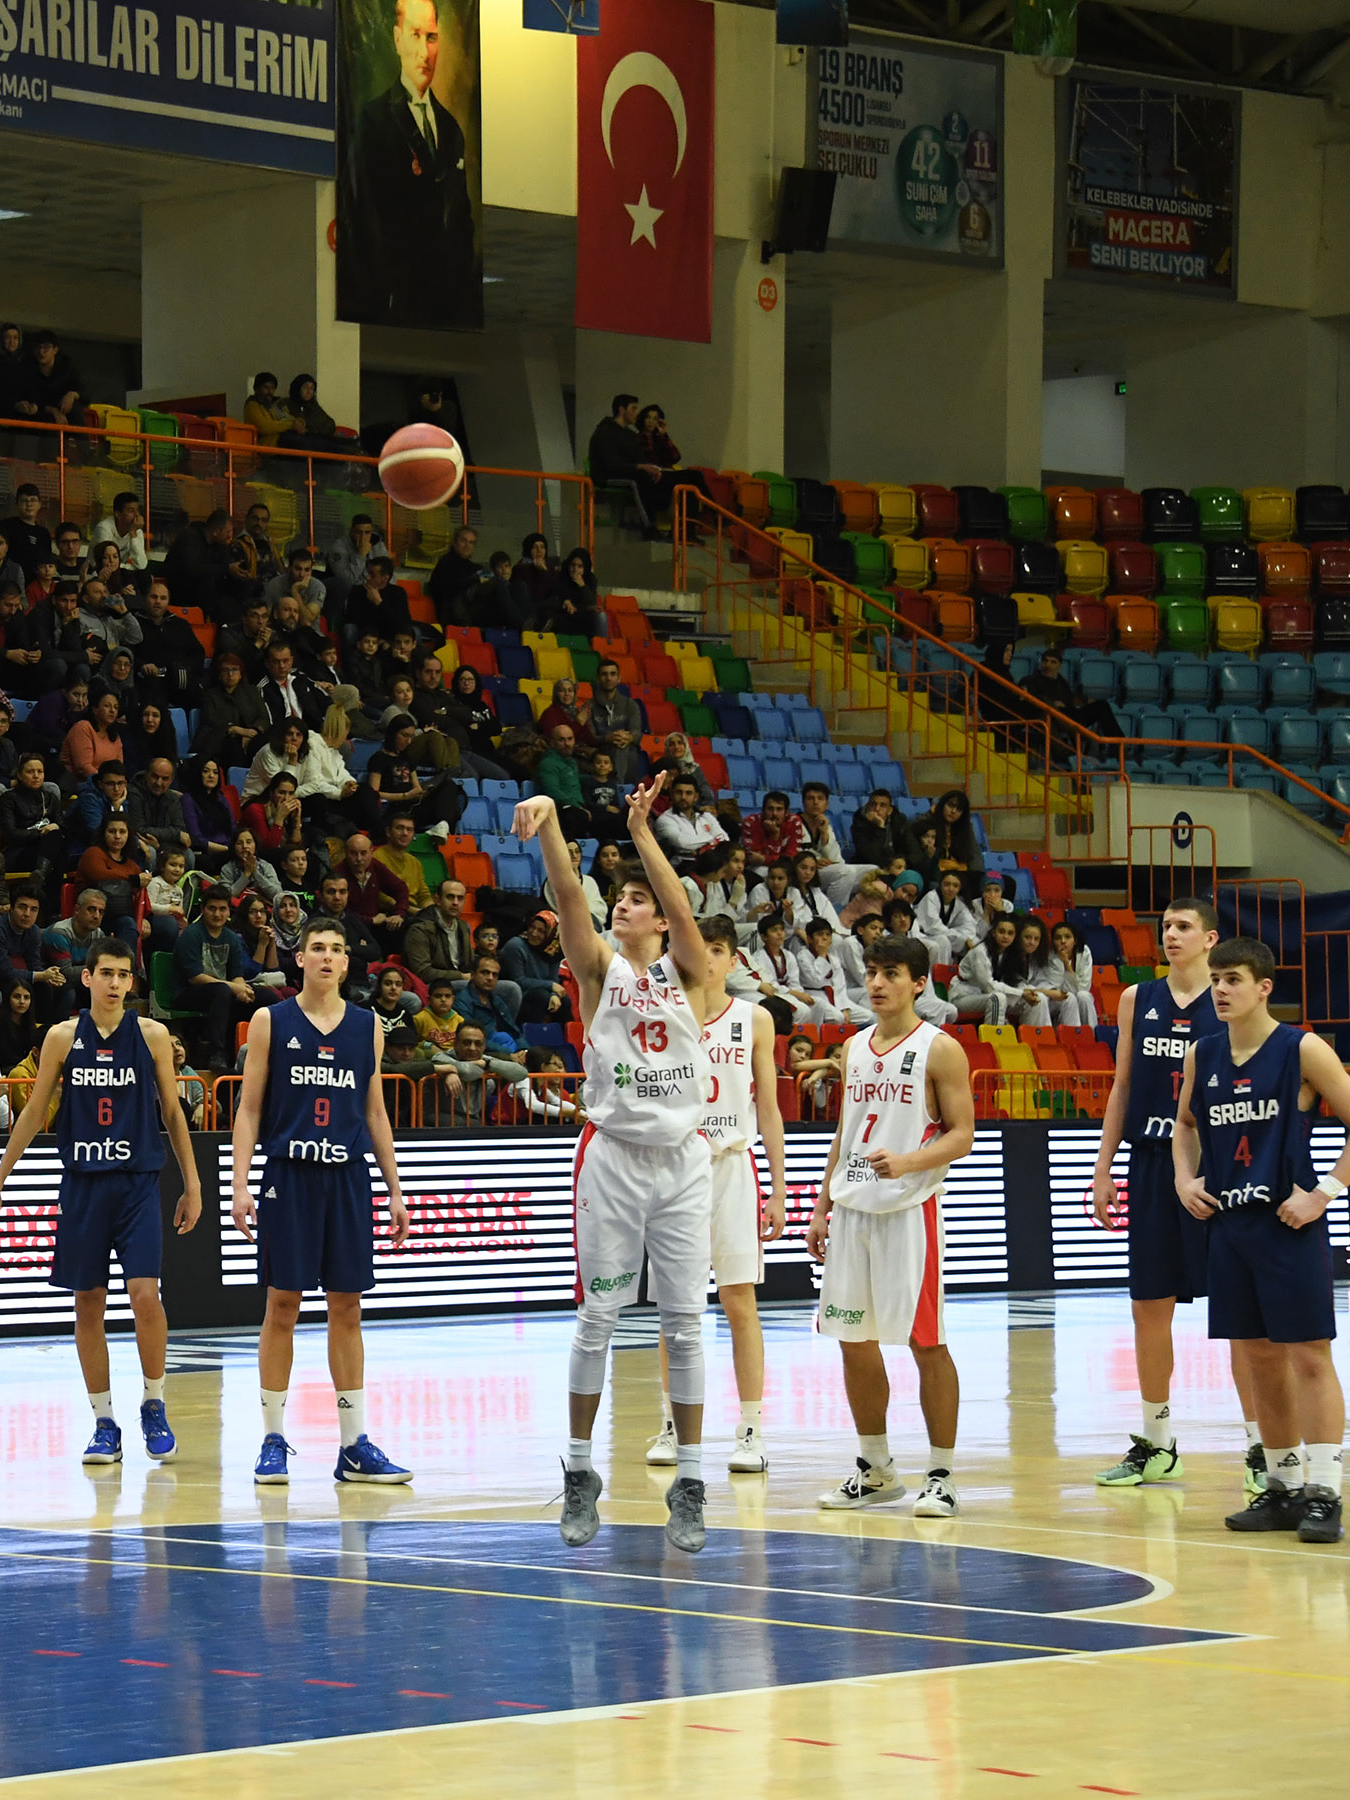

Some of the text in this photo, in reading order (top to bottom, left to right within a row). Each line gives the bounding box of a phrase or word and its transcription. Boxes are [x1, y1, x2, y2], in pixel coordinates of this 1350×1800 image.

[819, 49, 904, 99] 19 BRANŞ
[819, 87, 865, 128] 4500
[911, 140, 941, 181] 42
[973, 140, 991, 169] 11
[1086, 187, 1154, 211] KELEBEKLER
[1108, 216, 1191, 245] MACERA
[631, 1020, 669, 1053] 13
[1142, 1036, 1191, 1059] SRBI
[71, 1067, 137, 1087] SRBIJA
[290, 1065, 357, 1090] SRBIJA
[634, 1062, 695, 1083] Garanti
[637, 1083, 682, 1098] BBVA
[847, 1078, 914, 1105] TÜRKİYE
[97, 1097, 113, 1126] 6
[314, 1097, 331, 1127] 9
[1209, 1098, 1280, 1127] SRBIJA
[862, 1113, 878, 1144] 7
[73, 1137, 132, 1162] mts
[289, 1137, 349, 1164] mts
[1234, 1135, 1252, 1168] 4
[1217, 1182, 1271, 1211] mts
